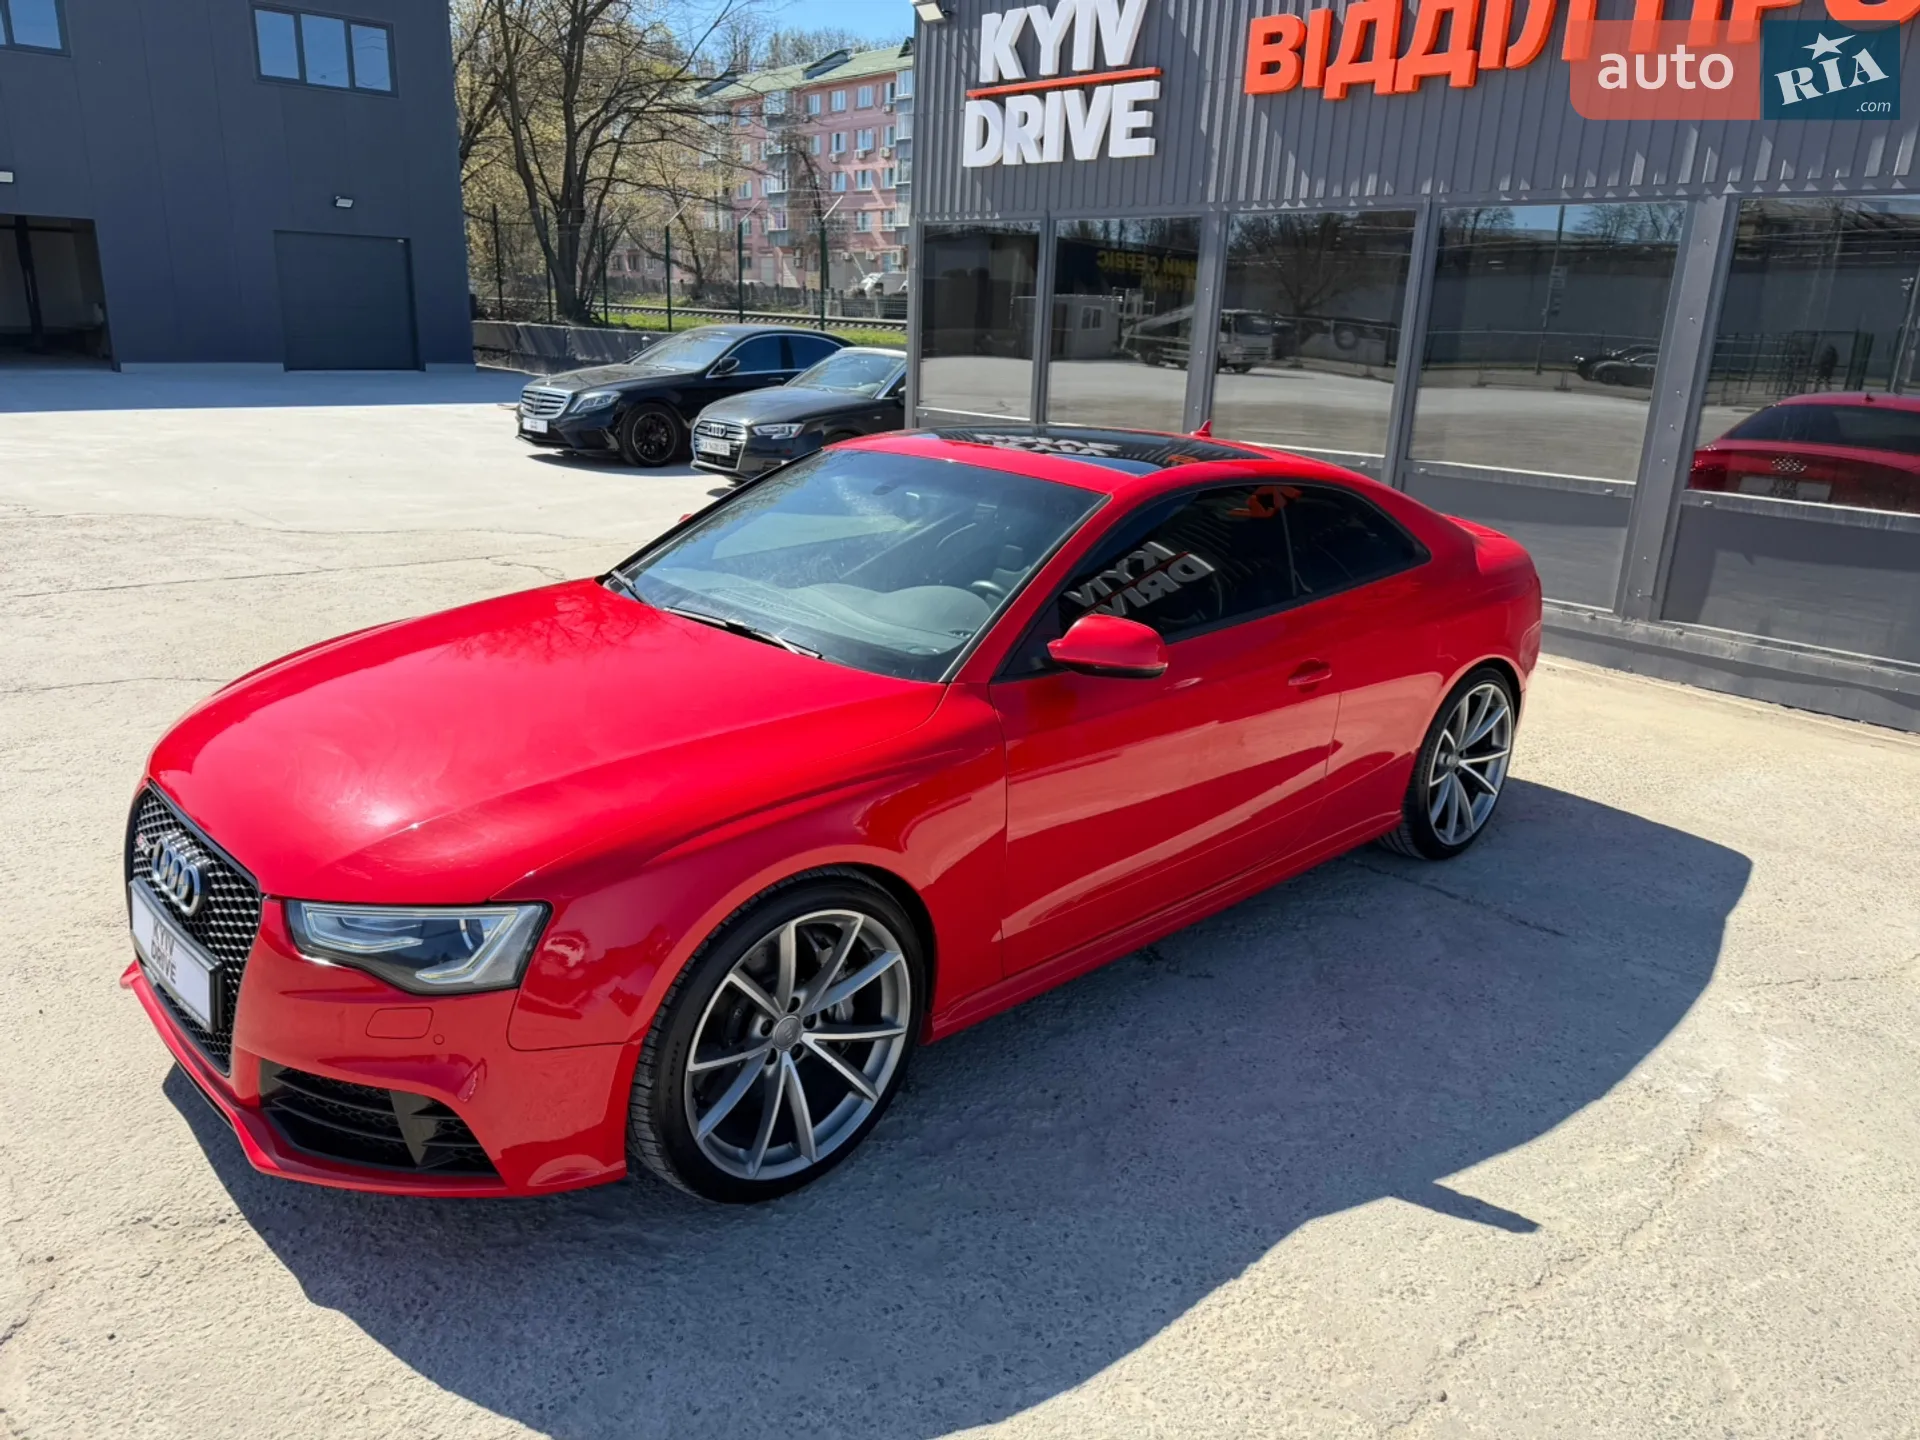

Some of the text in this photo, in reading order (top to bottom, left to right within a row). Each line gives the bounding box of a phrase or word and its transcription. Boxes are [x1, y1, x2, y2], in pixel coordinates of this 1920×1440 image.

[979, 0, 1148, 83] KYIV
[1245, 0, 1597, 99] ВІДДІЛ
[962, 80, 1160, 168] DRIVE
